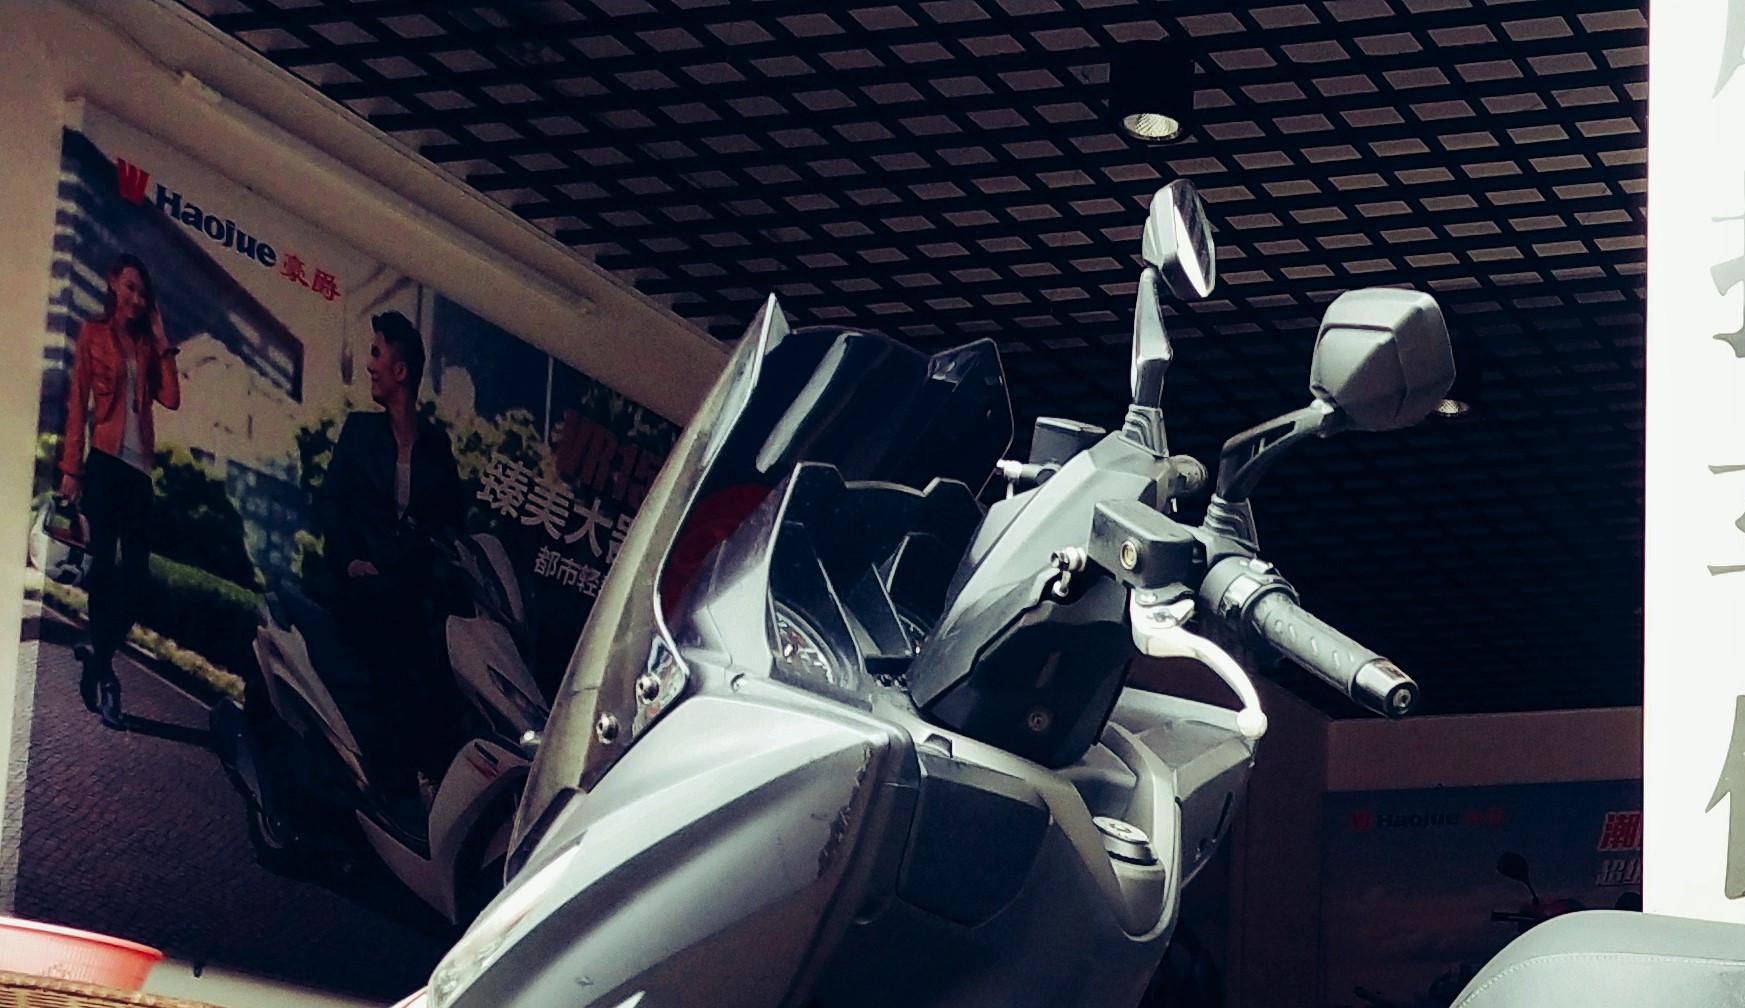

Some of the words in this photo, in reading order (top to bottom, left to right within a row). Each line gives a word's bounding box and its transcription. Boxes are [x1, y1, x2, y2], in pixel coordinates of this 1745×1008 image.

[154, 183, 278, 268] Haojue
[280, 252, 341, 301] 豪爵
[533, 545, 605, 598] 都市轻
